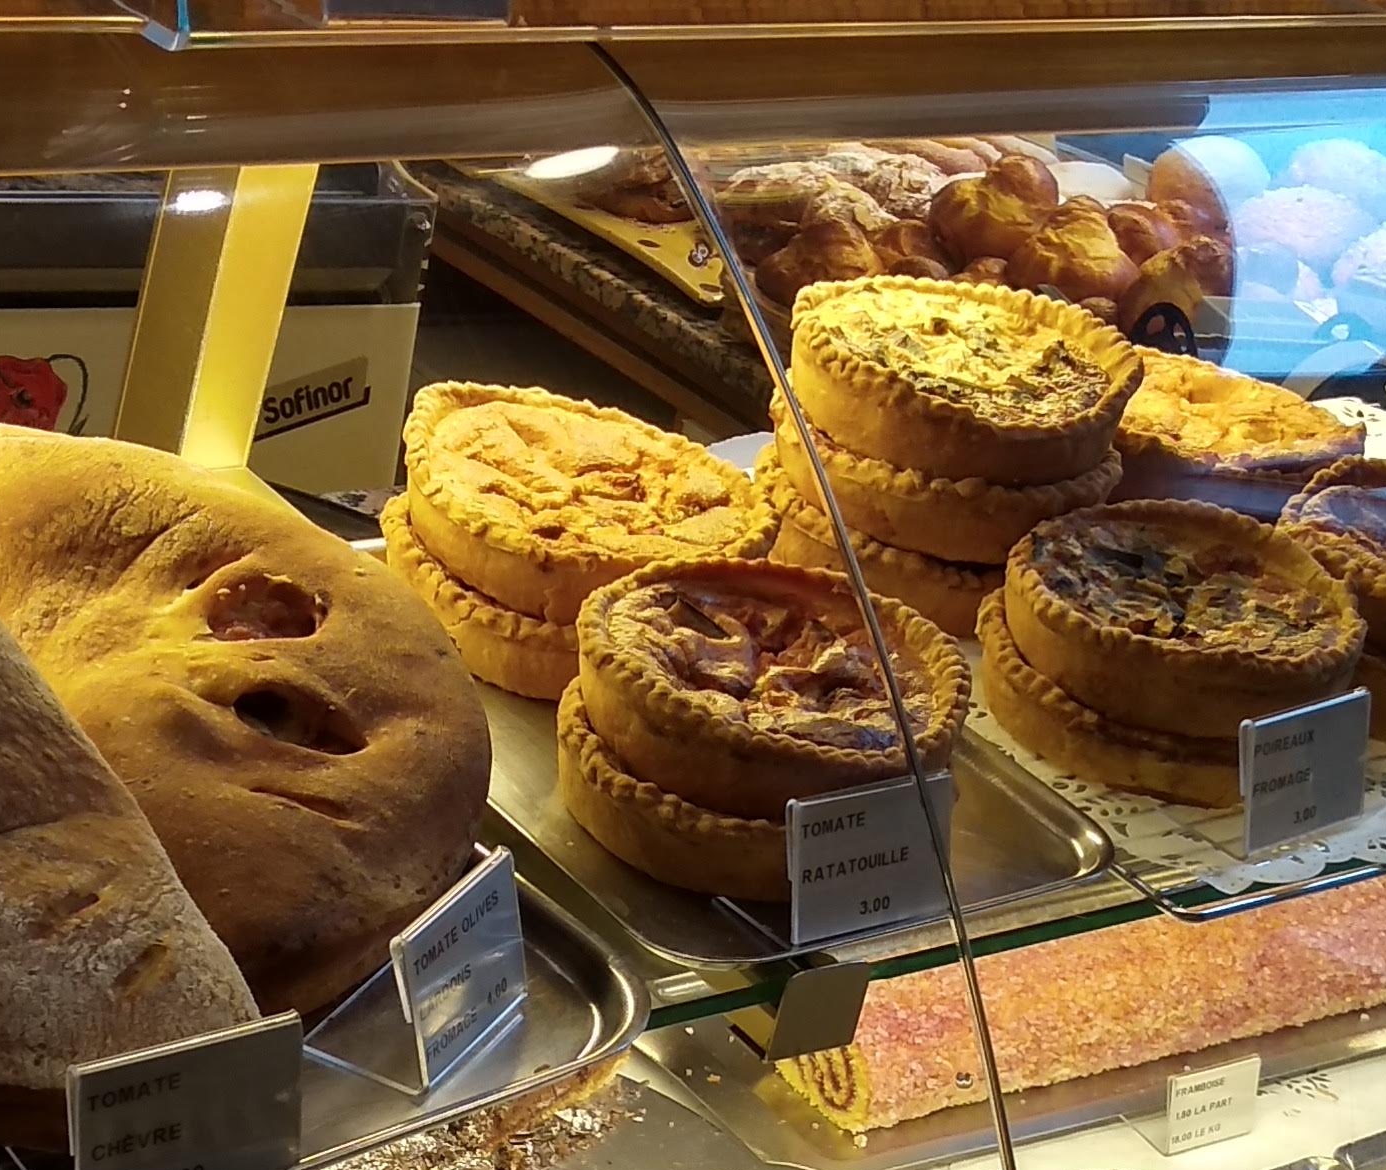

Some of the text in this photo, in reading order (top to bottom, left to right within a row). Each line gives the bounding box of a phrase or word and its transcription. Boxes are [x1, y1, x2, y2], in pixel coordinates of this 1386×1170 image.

[263, 376, 353, 425] Sofinor
[1255, 729, 1316, 758] POIREAUX
[1253, 767, 1312, 798] FROMAGE
[802, 811, 866, 840] TOMATE
[801, 846, 910, 884] RATATOUILLE
[413, 890, 500, 976] TOMATE OLIVES
[419, 963, 473, 1021] LARDONS
[426, 1008, 479, 1064] FROMAGE
[87, 1071, 182, 1113] TOMATE
[1175, 1077, 1226, 1098] FRAMBOISE
[1194, 1105, 1207, 1116] LA
[1209, 1097, 1233, 1111] PART
[1194, 1127, 1205, 1139] LE
